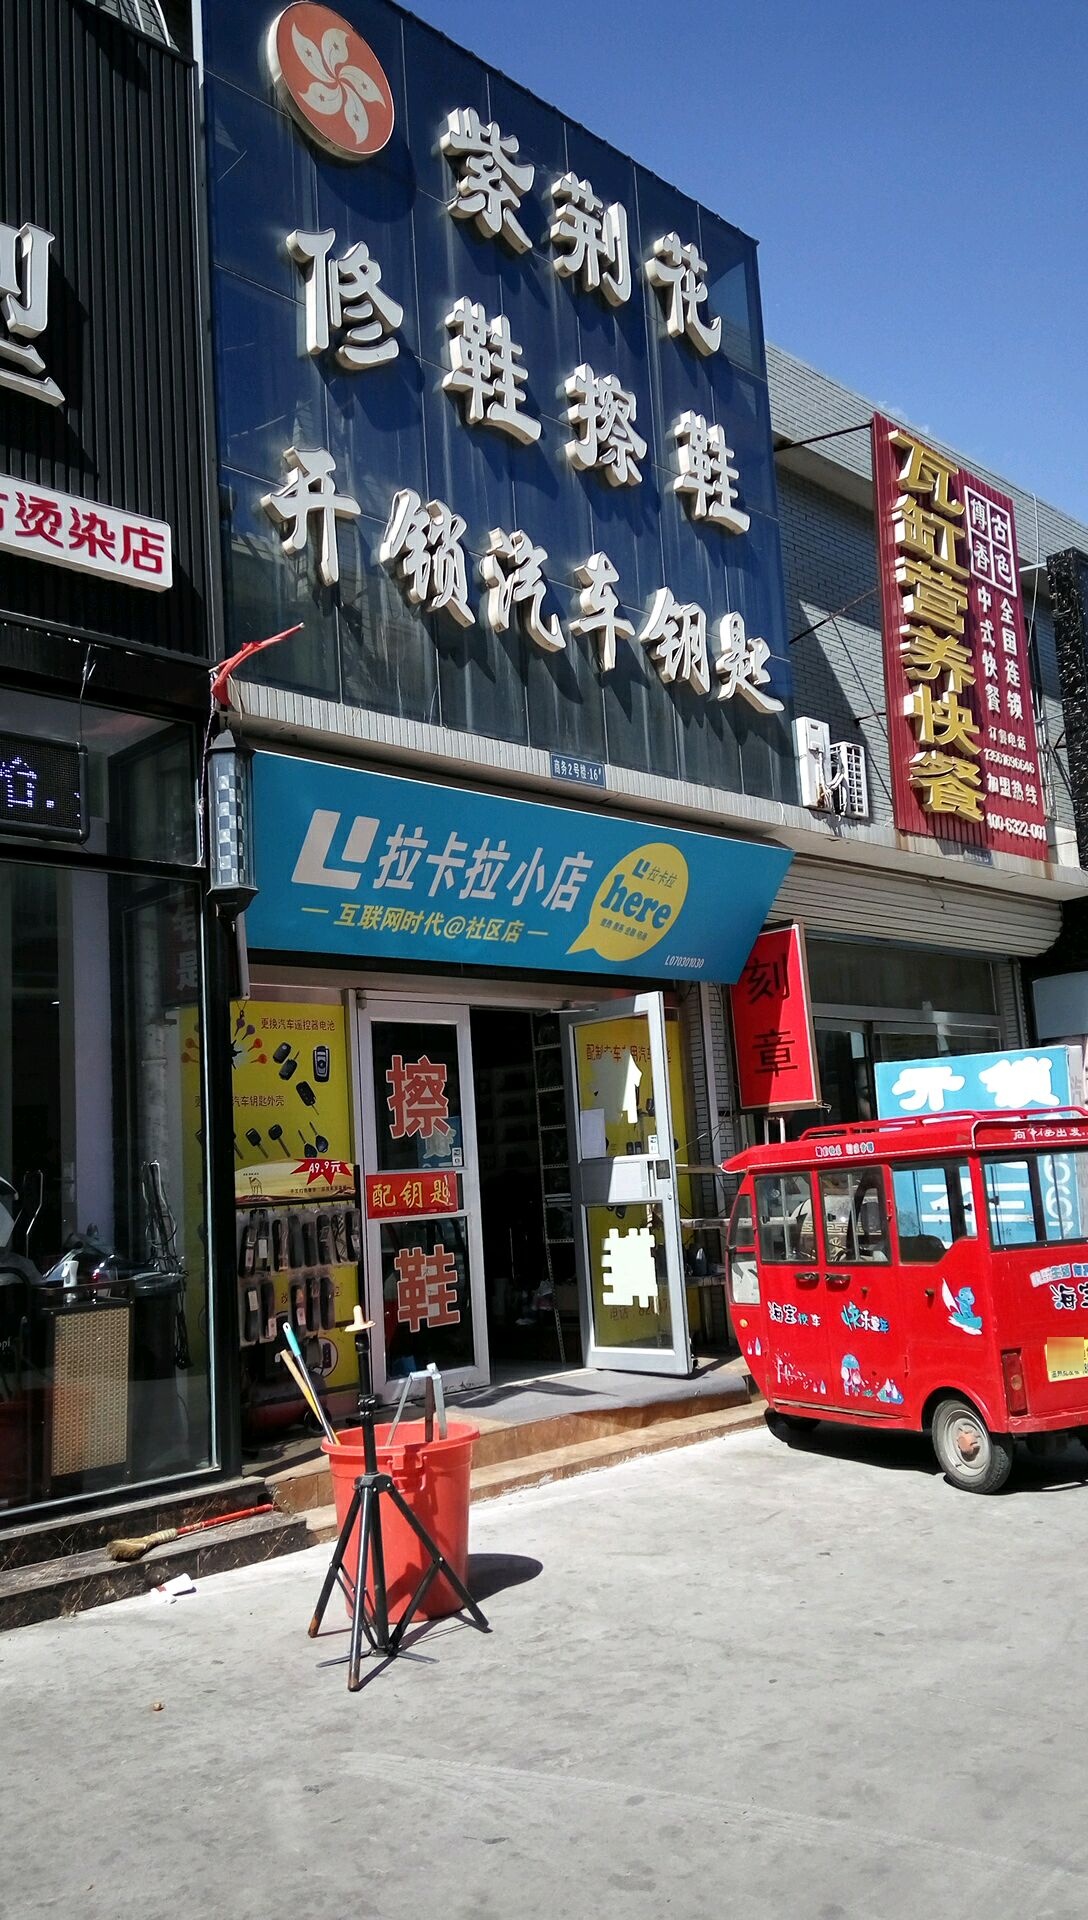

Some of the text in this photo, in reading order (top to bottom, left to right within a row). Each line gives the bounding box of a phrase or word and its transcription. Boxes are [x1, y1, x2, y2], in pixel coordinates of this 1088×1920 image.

[441, 107, 722, 357] 紫荆花
[286, 228, 751, 535] 修鞋擦鞋
[0, 490, 165, 574] 烫染店
[261, 446, 786, 714] 开锁汽车钥匙
[888, 429, 987, 824] 瓦缸营养快餐
[977, 586, 1000, 713] 中式快餐
[1000, 598, 1023, 720] 全国连锁
[988, 725, 1026, 751] 订餐电话
[986, 772, 1038, 806] 加盟热线
[372, 824, 593, 913] 拉卡拉小店
[600, 874, 672, 929] here
[648, 865, 678, 888] 拉卡拉
[334, 902, 525, 943] 互联网时代@社区店
[260, 1017, 336, 1032] 更换汽车遥控器电池
[745, 953, 798, 1077] 刻章
[386, 1055, 450, 1139] 擦
[372, 1179, 453, 1208] 配钥匙
[394, 1244, 461, 1332] 鞋
